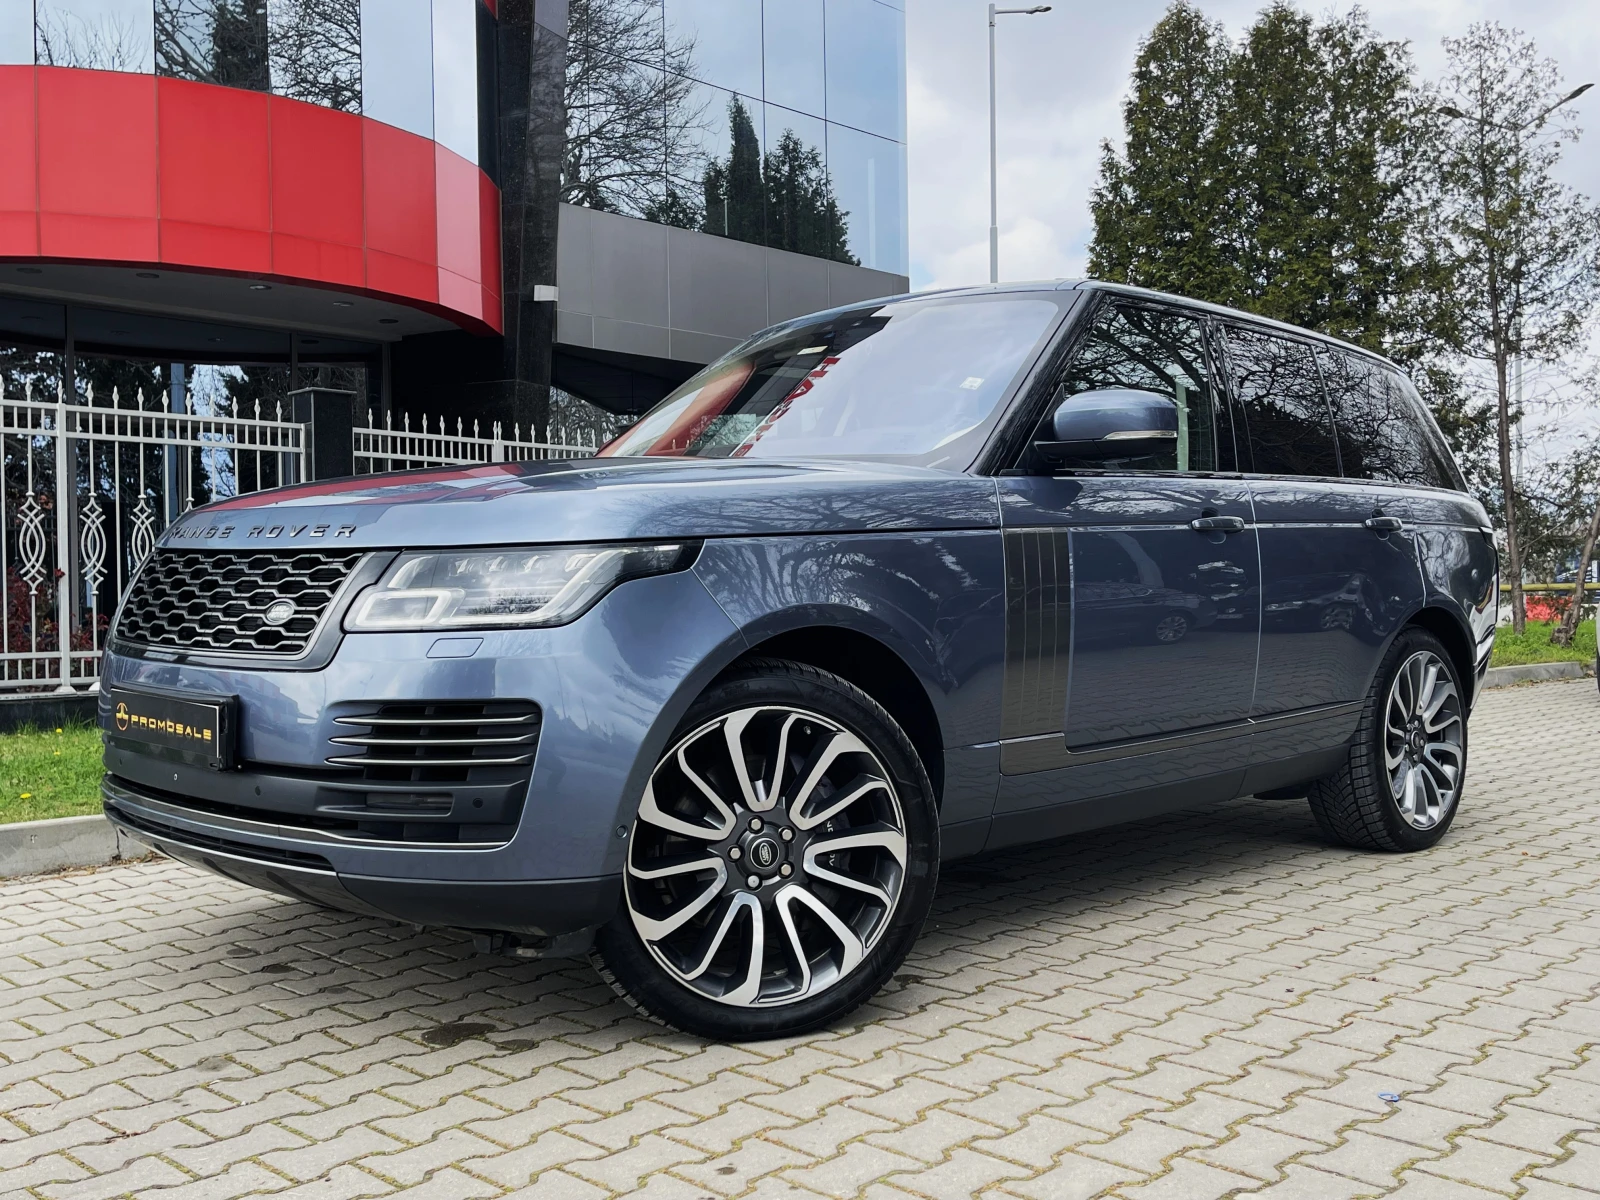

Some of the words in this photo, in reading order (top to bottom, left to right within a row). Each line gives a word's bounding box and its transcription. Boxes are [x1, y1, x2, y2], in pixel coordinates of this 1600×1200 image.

[169, 525, 236, 539] RANGE
[246, 524, 357, 539] ROVER
[130, 714, 212, 741] PROMOSALE
